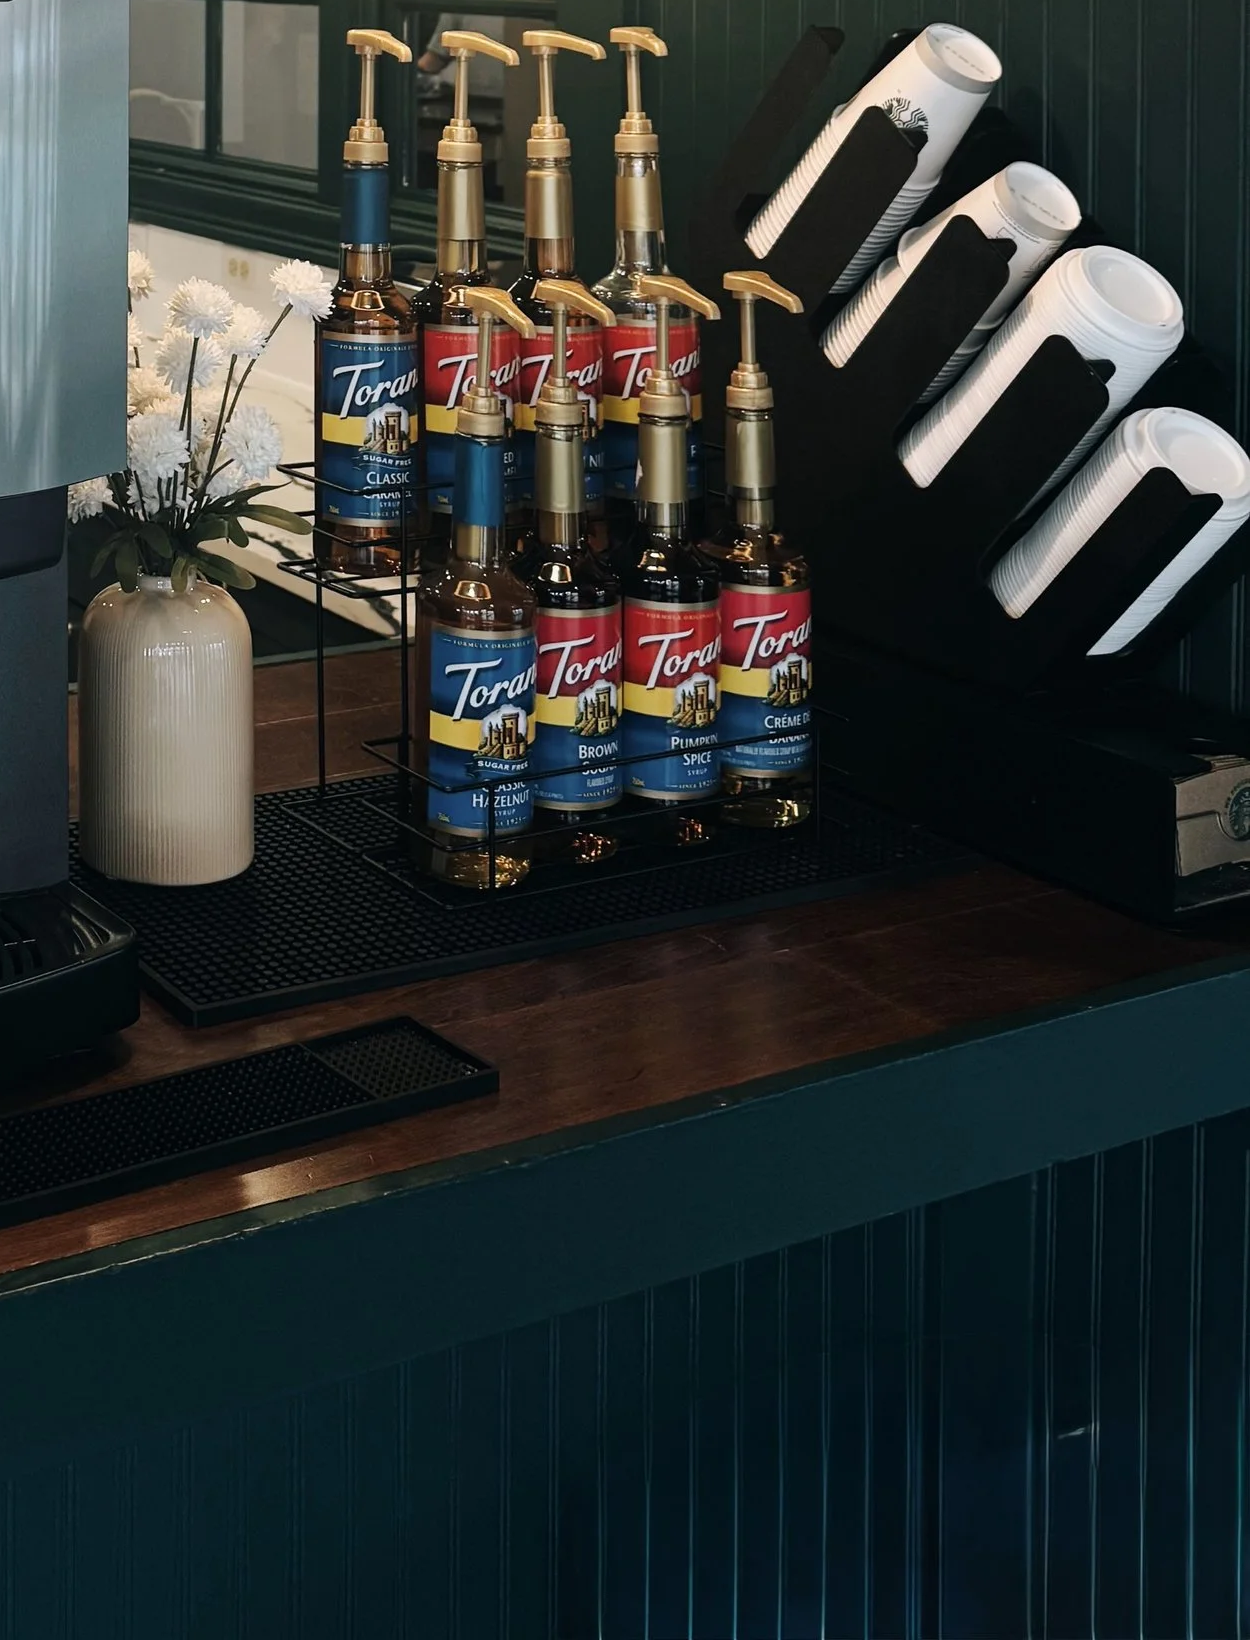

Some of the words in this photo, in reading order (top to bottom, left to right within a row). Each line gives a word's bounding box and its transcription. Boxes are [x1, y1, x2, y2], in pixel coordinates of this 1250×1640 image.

[333, 360, 418, 419] Toran
[363, 454, 394, 465] SUGAR
[366, 471, 410, 485] CLASSIC
[538, 633, 622, 699] Toran
[638, 627, 721, 690] Toran
[445, 657, 537, 721] Toran
[578, 740, 618, 759] BROWN
[671, 733, 718, 750] PUMPKIN
[477, 760, 510, 771] SUGAR
[511, 761, 528, 771] FREE
[683, 751, 712, 766] SPICE
